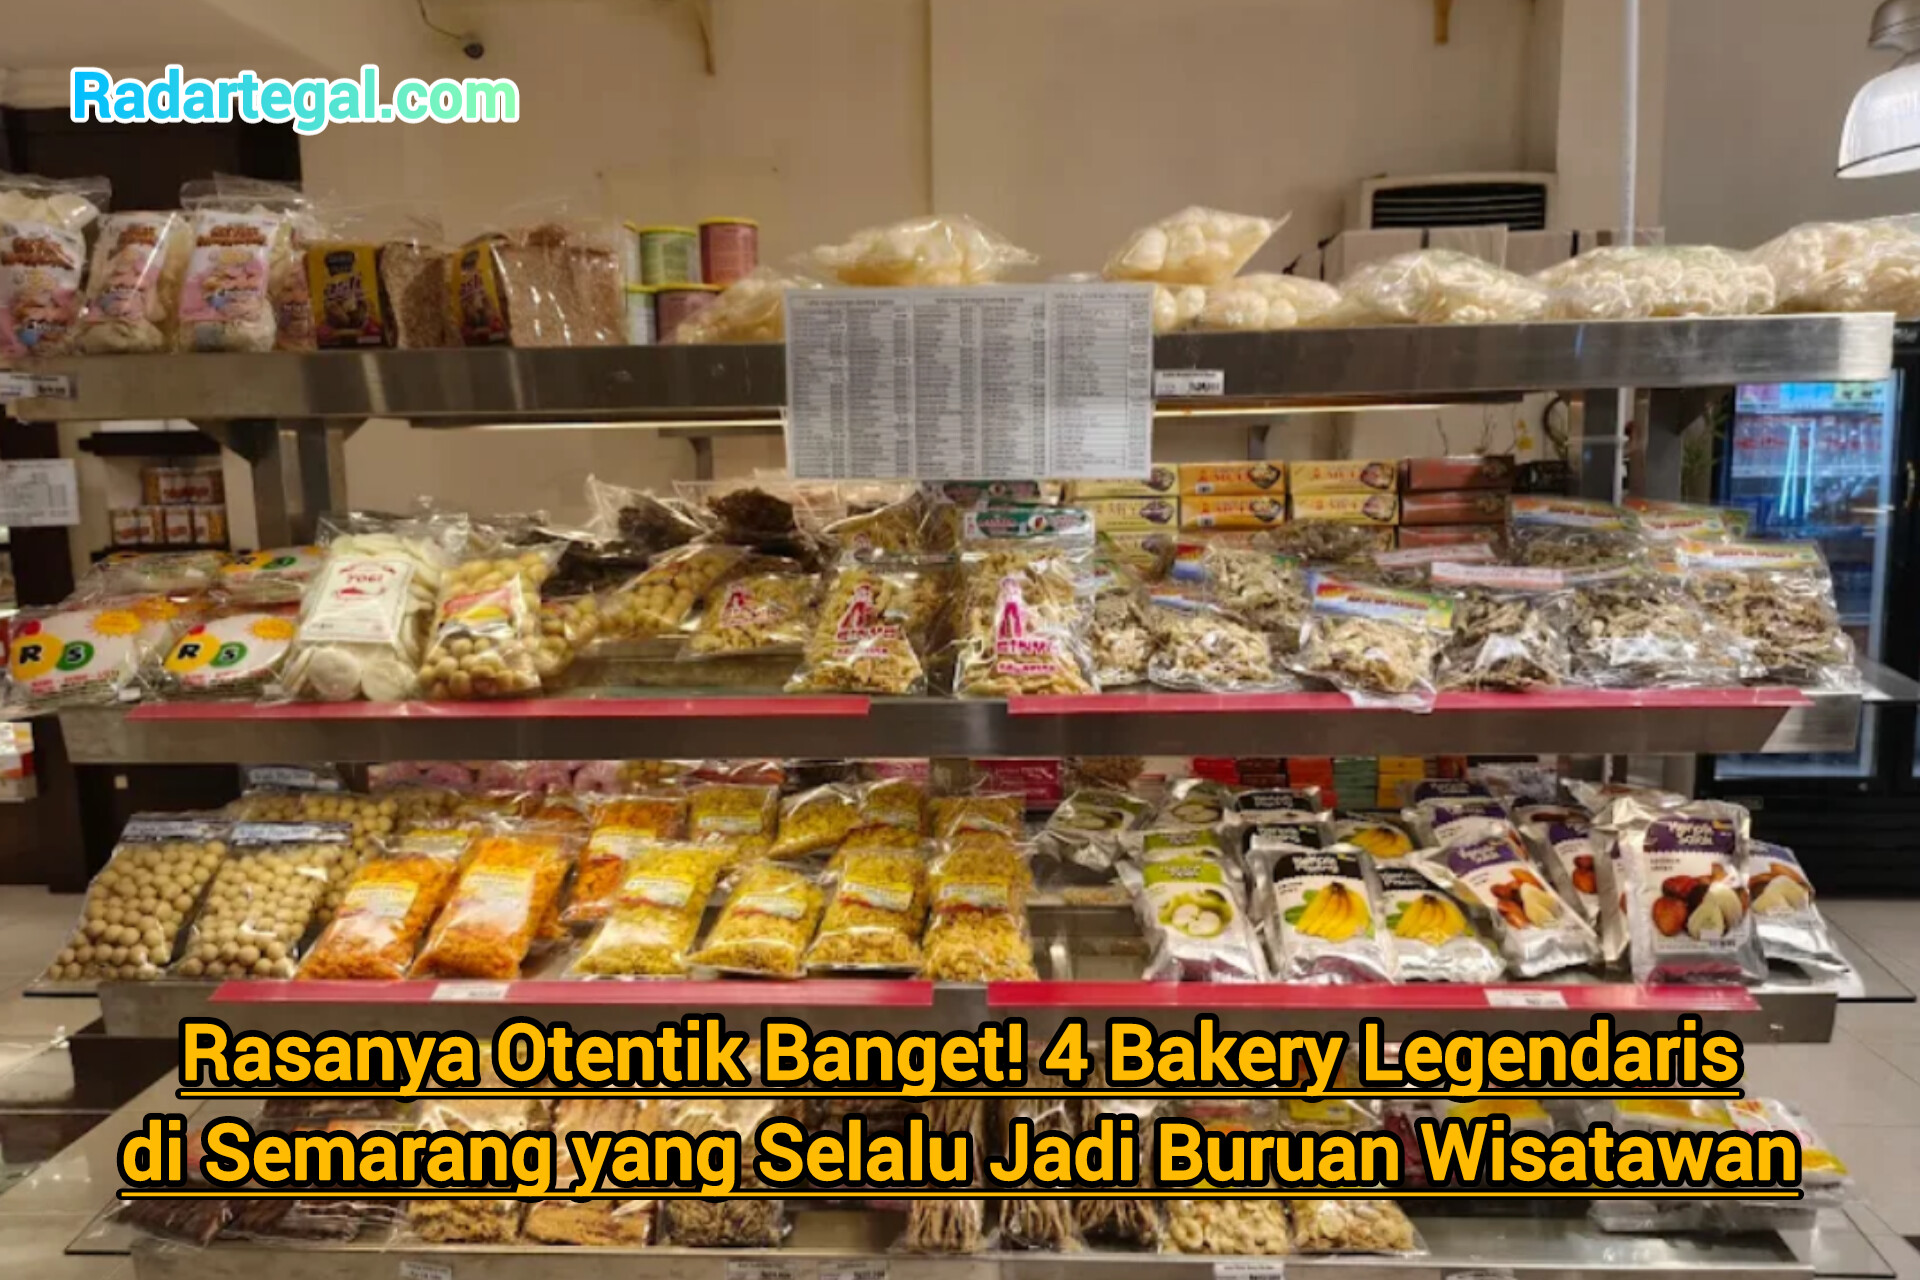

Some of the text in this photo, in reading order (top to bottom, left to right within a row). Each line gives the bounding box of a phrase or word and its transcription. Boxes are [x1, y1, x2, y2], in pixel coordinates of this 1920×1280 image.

[19, 641, 84, 664] R S
[177, 643, 201, 659] R
